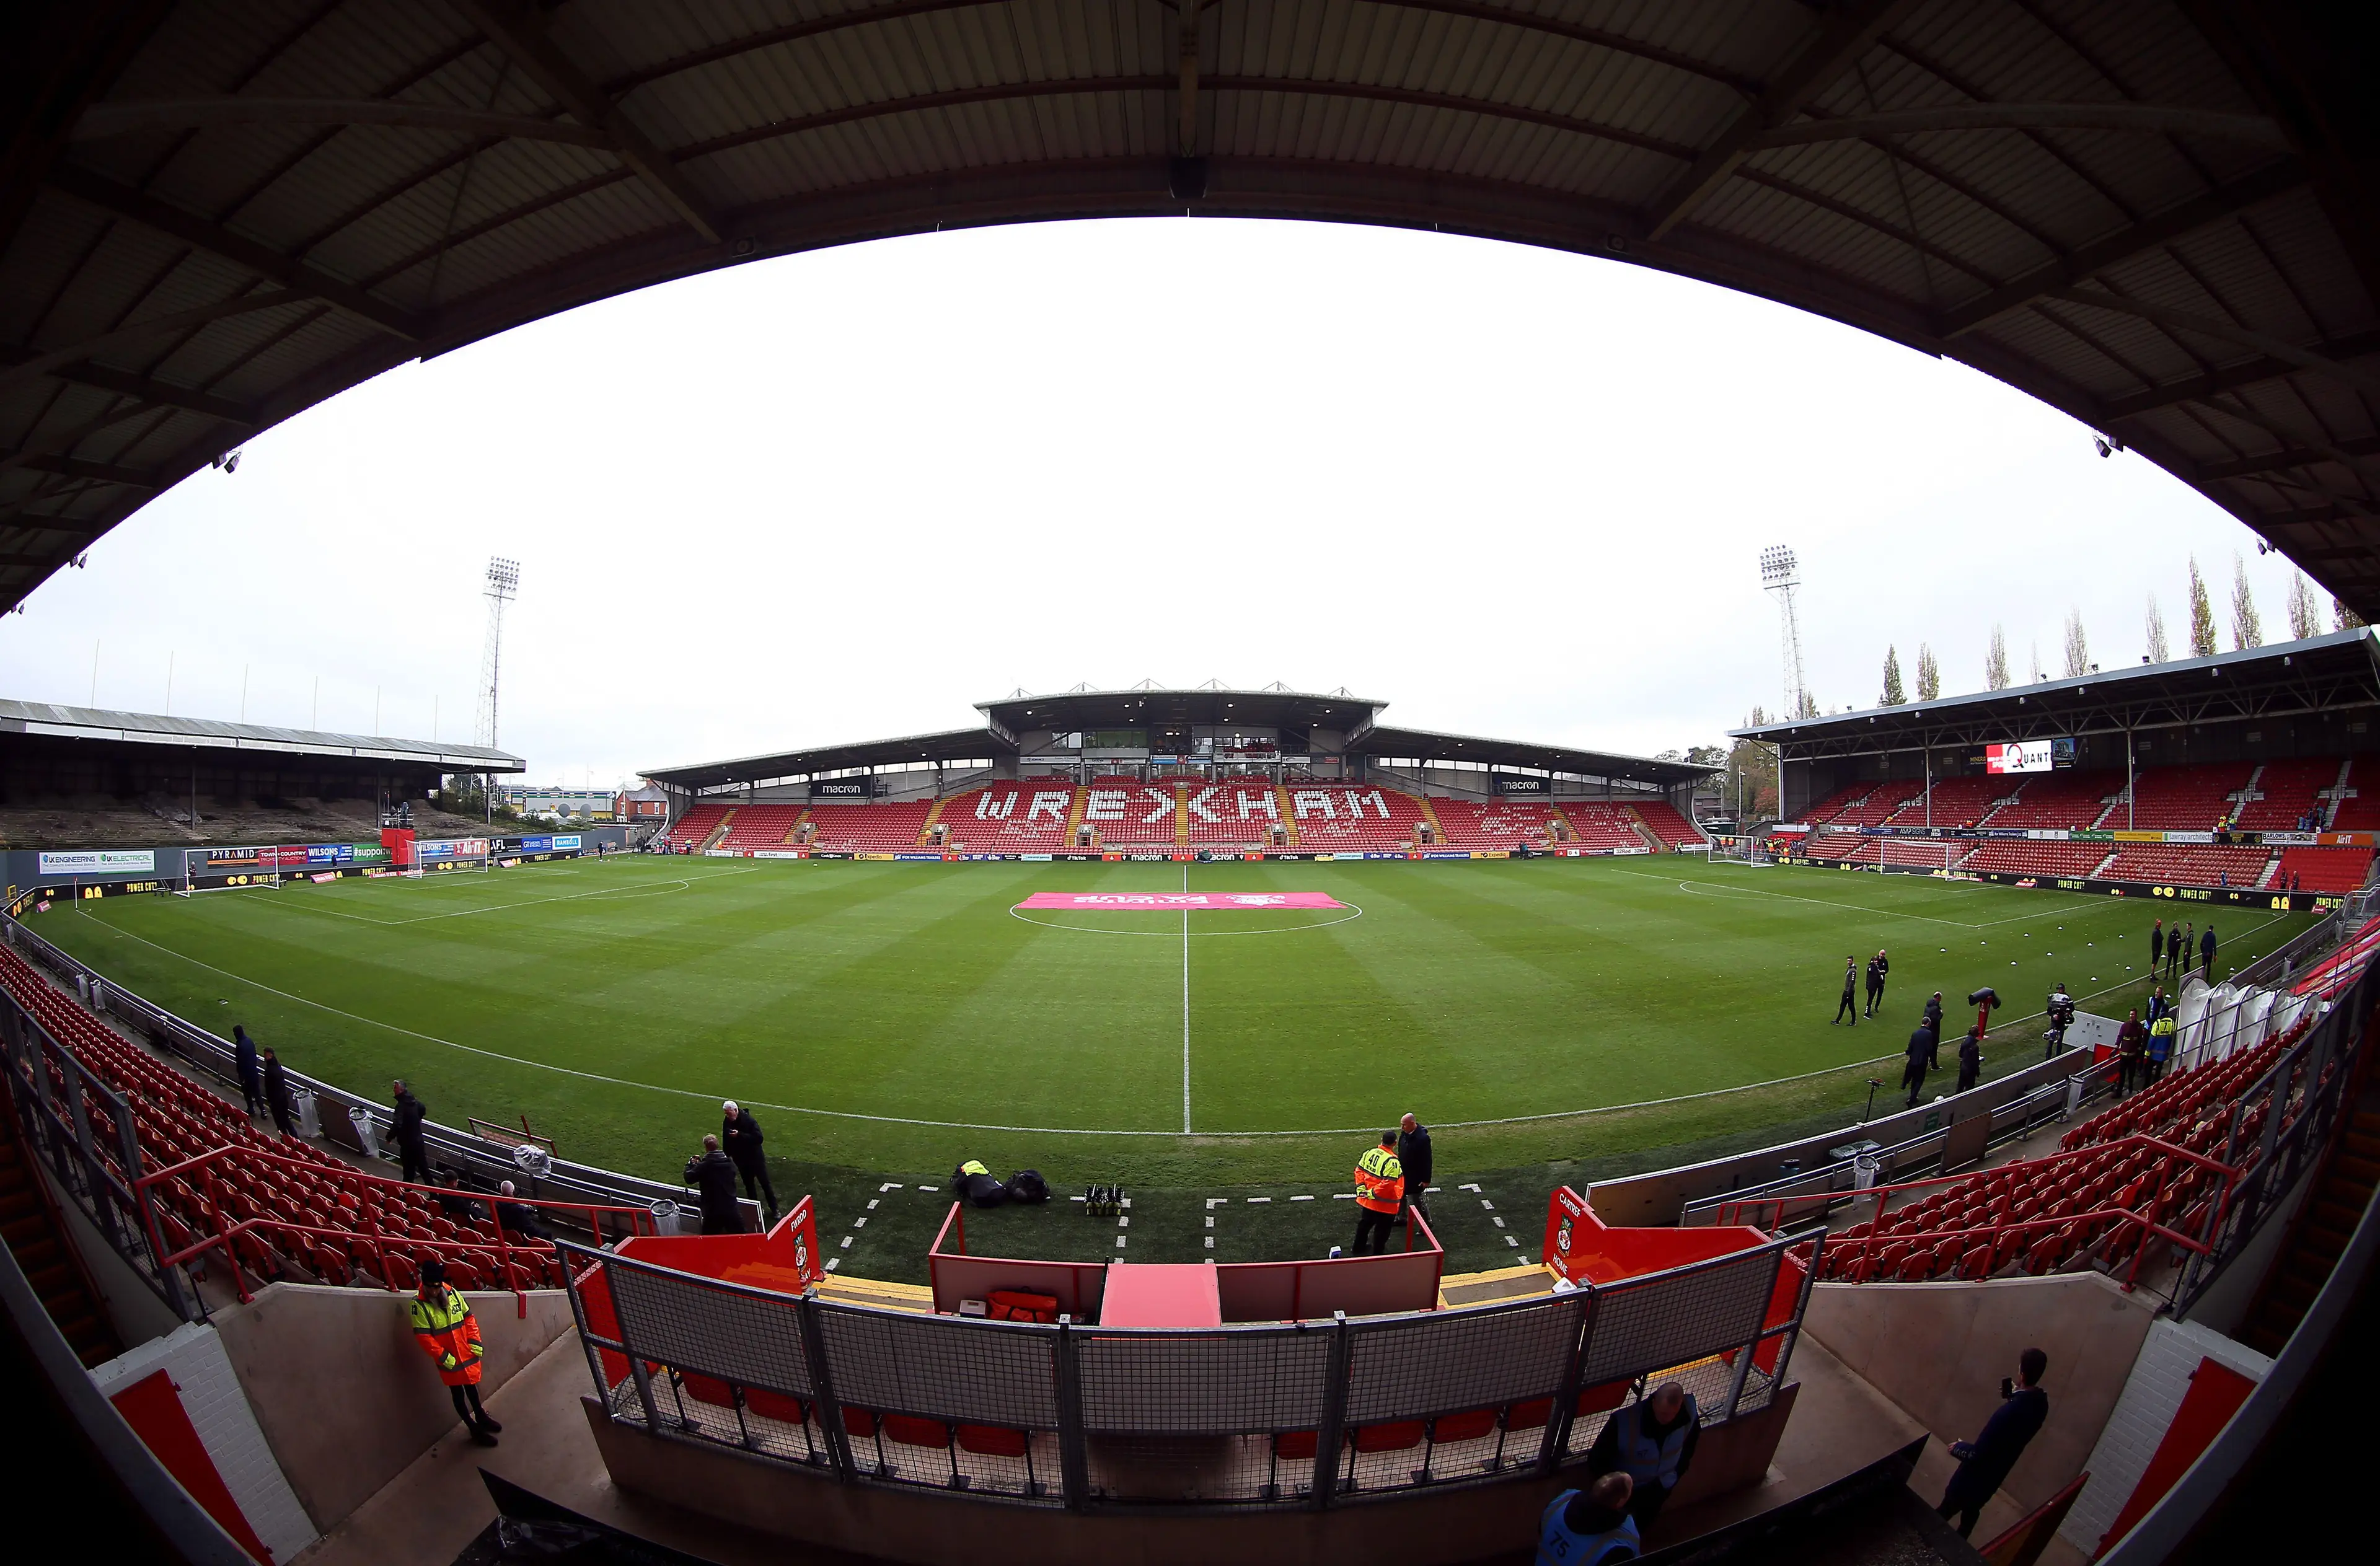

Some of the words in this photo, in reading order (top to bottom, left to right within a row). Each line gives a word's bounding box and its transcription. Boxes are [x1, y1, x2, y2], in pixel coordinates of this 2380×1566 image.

[2007, 744, 2048, 768] QUANT
[822, 785, 860, 793] macron
[1502, 781, 1539, 790] macron
[976, 787, 1390, 824] WREXHAM
[2170, 832, 2186, 840] lawray
[2187, 832, 2213, 840] architects
[212, 850, 255, 859] PYRAMID
[308, 847, 338, 856] WILSONS
[126, 883, 144, 892] POWER
[2058, 879, 2073, 889] POWER
[2073, 880, 2085, 890] CUT?
[2180, 889, 2197, 899] POWER
[2198, 890, 2211, 900] CUT?
[1368, 1154, 1380, 1167] 40
[1559, 1193, 1580, 1218] CARTREF
[791, 1209, 807, 1232] FWRDD
[1553, 1253, 1568, 1275] HOME
[1550, 1530, 1570, 1558] 75
